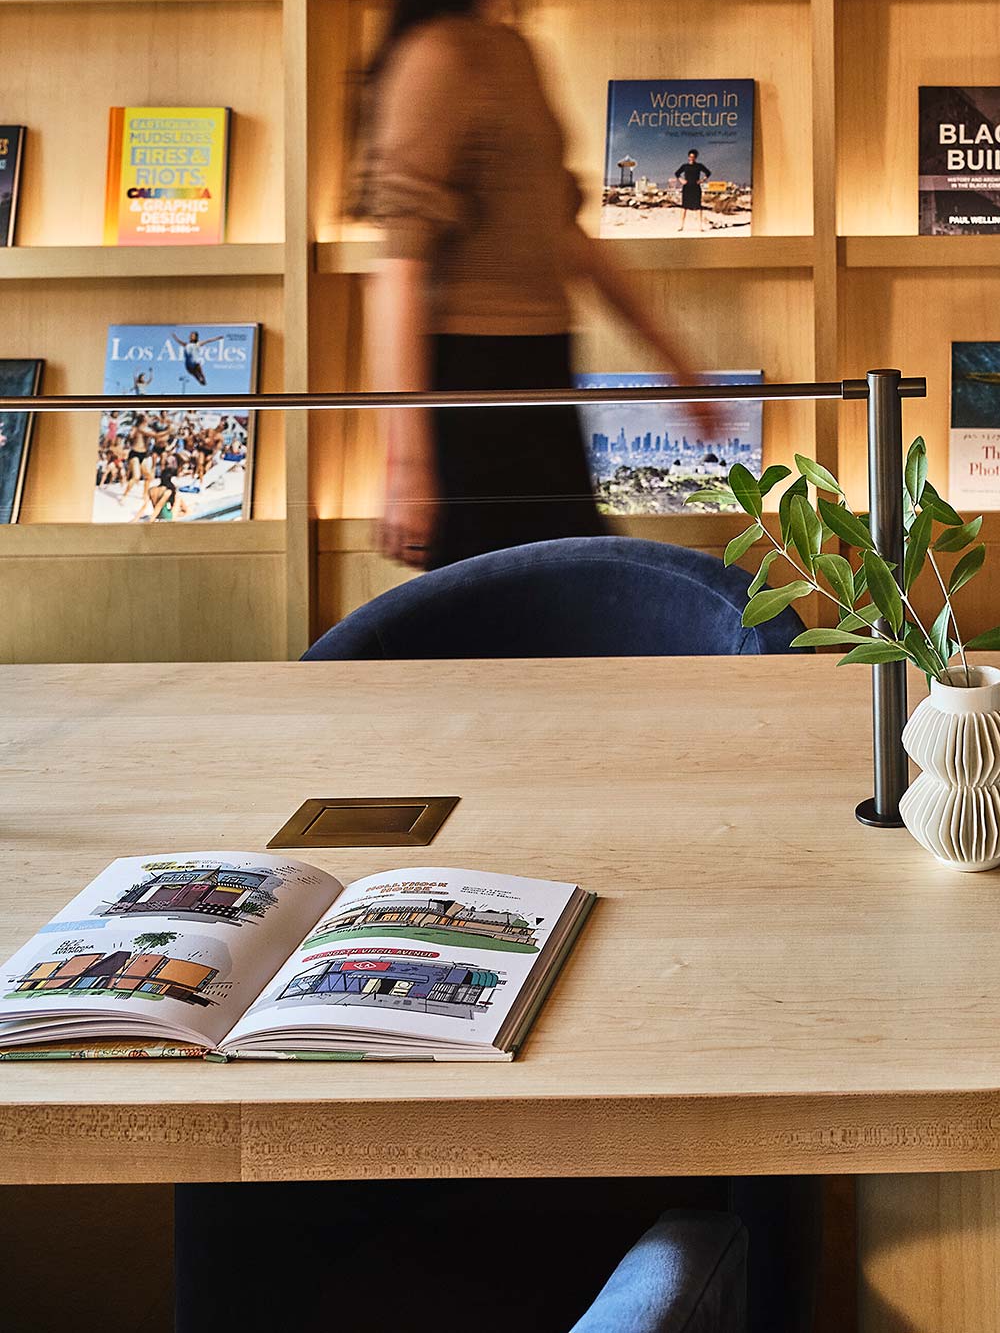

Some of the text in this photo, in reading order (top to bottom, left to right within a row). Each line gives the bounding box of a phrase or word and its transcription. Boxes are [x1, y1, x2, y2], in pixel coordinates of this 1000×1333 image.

[650, 91, 739, 109] Women in
[627, 110, 738, 127] Architecture
[135, 148, 208, 164] FIRES &
[130, 199, 209, 212] & GRAPHIC
[141, 212, 196, 224] DESIGN
[949, 216, 970, 224] PAUL
[111, 338, 153, 361] Los
[326, 949, 358, 957] NORTH
[396, 949, 434, 957] AVENUE
